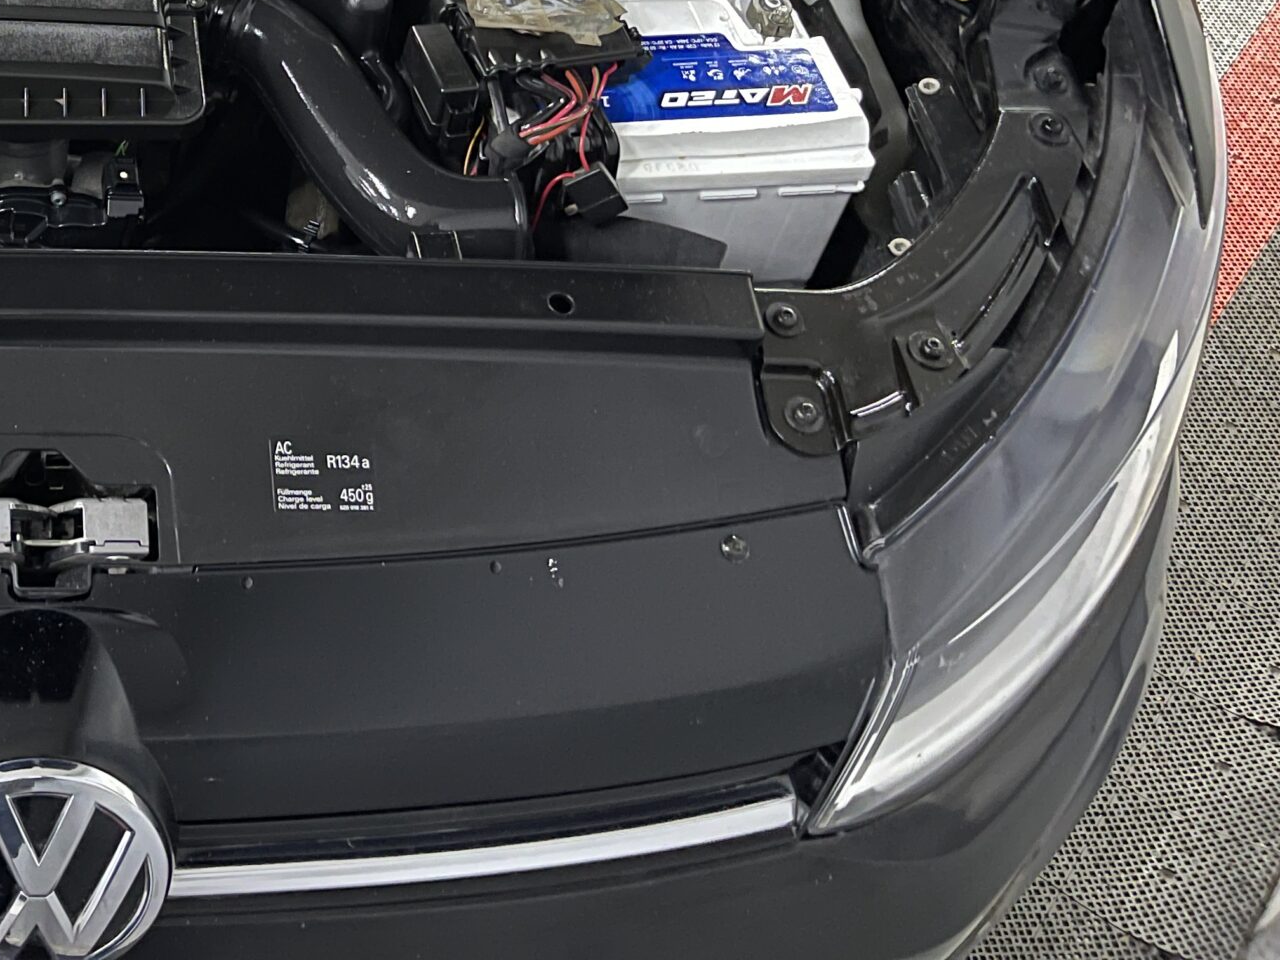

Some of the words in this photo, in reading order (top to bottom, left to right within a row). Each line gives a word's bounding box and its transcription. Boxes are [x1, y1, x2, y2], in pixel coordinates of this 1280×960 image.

[660, 83, 813, 108] MATEO
[274, 440, 292, 454] AC
[326, 455, 360, 469] R134
[362, 458, 370, 469] a
[340, 488, 364, 502] 450
[365, 492, 374, 505] g
